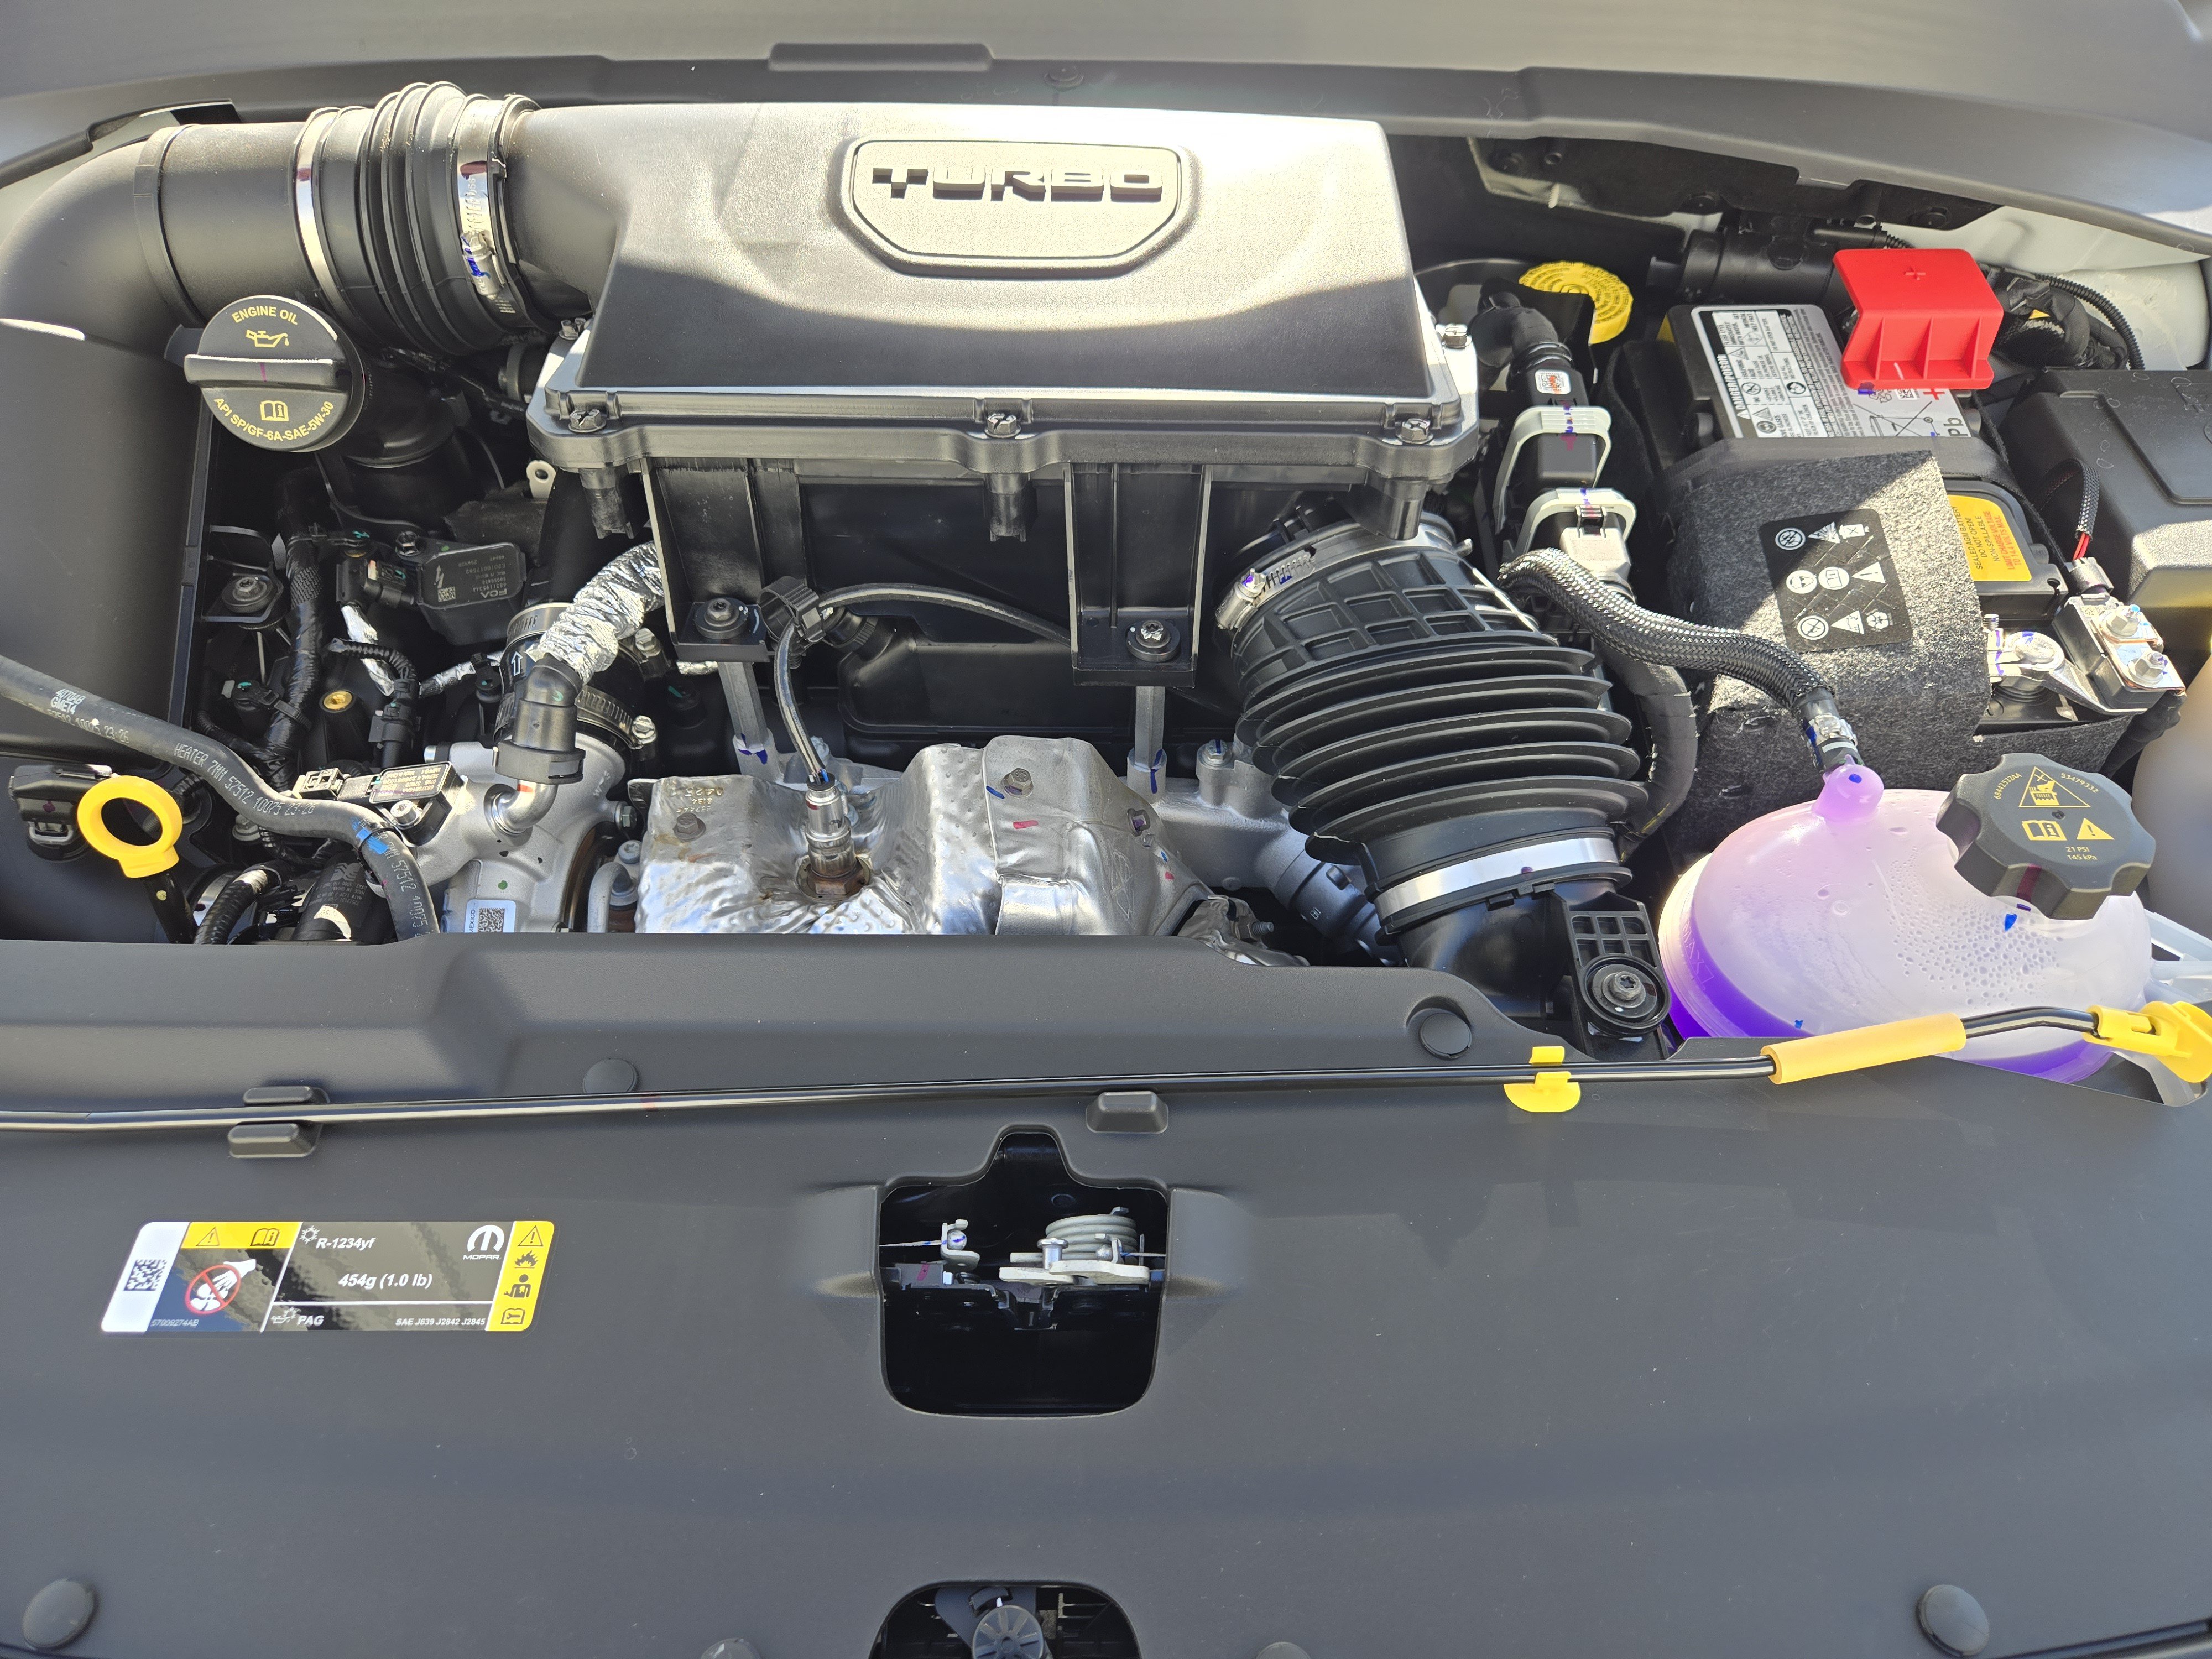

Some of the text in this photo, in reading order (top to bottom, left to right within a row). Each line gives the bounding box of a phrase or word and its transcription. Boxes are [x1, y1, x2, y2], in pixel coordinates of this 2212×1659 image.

[872, 166, 1163, 202] TURBO
[232, 306, 298, 325] ENGINE OIL
[1717, 354, 1746, 409] DANGER/POISON
[214, 398, 231, 417] API
[1966, 517, 1978, 534] OPEN!
[1952, 506, 1983, 569] SEALED AGM BATTERY
[1974, 536, 1983, 547] NOT
[1975, 515, 2001, 561] NON-SPILLABLE
[1983, 510, 2015, 569] LIMIT CHARGE VOLTAGE
[2000, 529, 2012, 545] VOLTS
[50, 697, 77, 714] GMET4
[56, 688, 86, 705] 4070AB
[174, 743, 319, 816] HEATER 7MM 57512 10075 23:26
[2061, 773, 2099, 793] 53479332
[392, 860, 418, 893] 57512
[316, 1237, 377, 1251] R-1234yf
[338, 1273, 432, 1290] 454g (1.0 lb)
[297, 1316, 324, 1326] PAG
